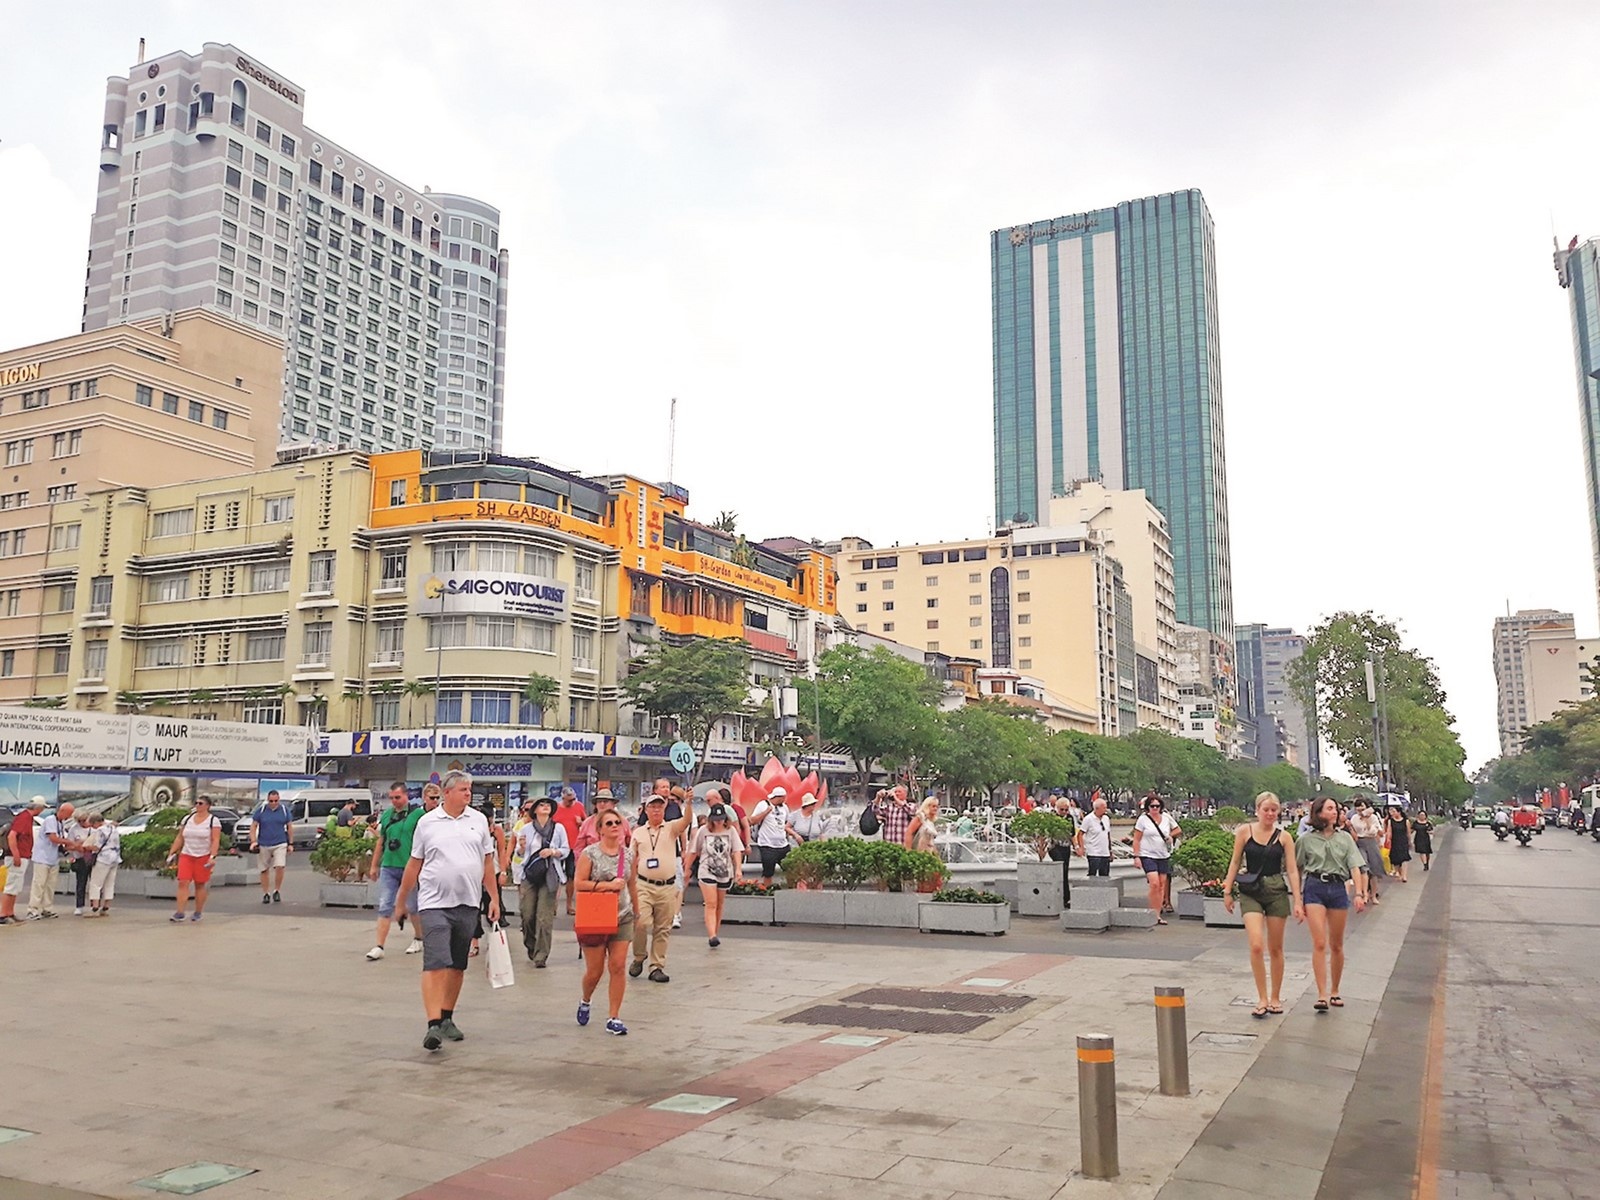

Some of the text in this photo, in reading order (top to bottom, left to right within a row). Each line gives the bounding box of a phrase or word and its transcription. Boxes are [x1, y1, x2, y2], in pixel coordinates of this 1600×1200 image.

[236, 56, 299, 104] Sheraton
[477, 501, 561, 525] SH GARDEN
[448, 579, 565, 604] SAIGONTOURIST
[155, 723, 188, 738] MAUR
[441, 734, 547, 751] Information
[552, 738, 596, 752] Center
[153, 748, 182, 762] NJPT
[677, 752, 691, 765] 40
